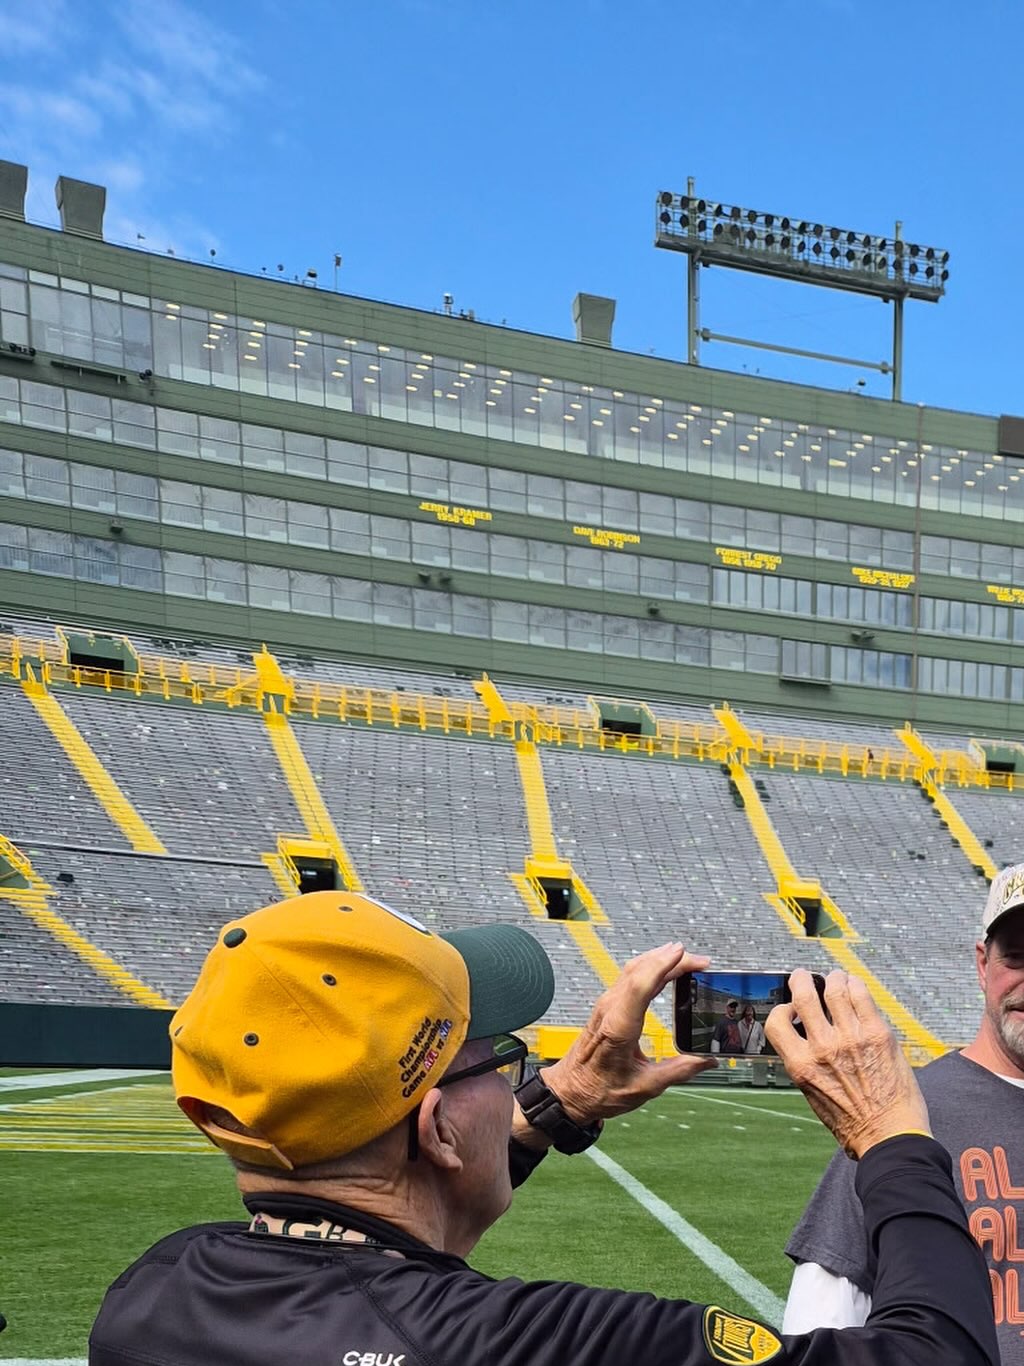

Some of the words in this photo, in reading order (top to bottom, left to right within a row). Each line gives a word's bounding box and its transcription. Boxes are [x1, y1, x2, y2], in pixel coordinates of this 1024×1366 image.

[419, 502, 449, 514] JERRY
[453, 506, 492, 521] KRAMER
[398, 1046, 417, 1069] First
[412, 1015, 432, 1046] World
[401, 1018, 442, 1082] Championship
[402, 1070, 426, 1098] Game
[424, 1049, 439, 1071] AFL
